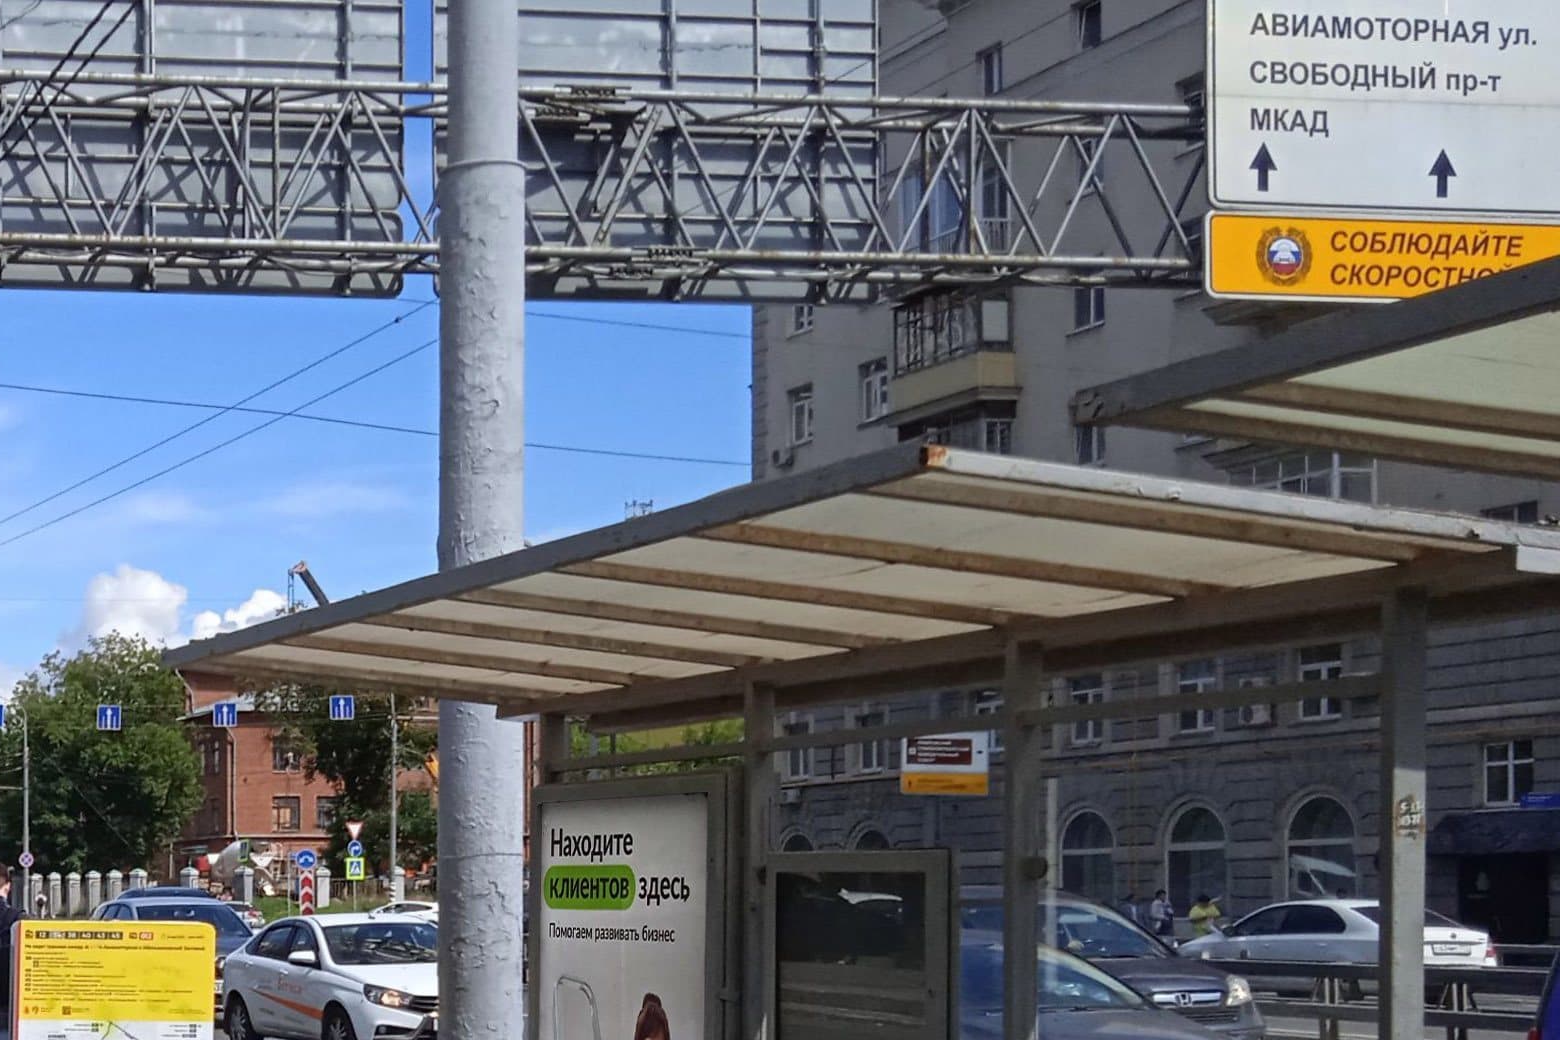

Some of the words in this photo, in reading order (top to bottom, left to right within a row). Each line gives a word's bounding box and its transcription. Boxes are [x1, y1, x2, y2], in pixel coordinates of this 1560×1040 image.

[1250, 13, 1489, 44] АВИАМОТОРНАЯ
[1498, 27, 1537, 51] ул.
[1250, 60, 1436, 92] СВОБОДНЫЙ
[1445, 73, 1501, 96] пр-т
[1250, 108, 1330, 137] МКАД
[1330, 229, 1524, 260] СОБЛЮДАЙТЕ
[550, 828, 633, 863] Находите
[549, 877, 629, 900] клиентов
[549, 922, 593, 940] Помогаем
[594, 926, 640, 943] развивать
[641, 925, 676, 943] бизнес
